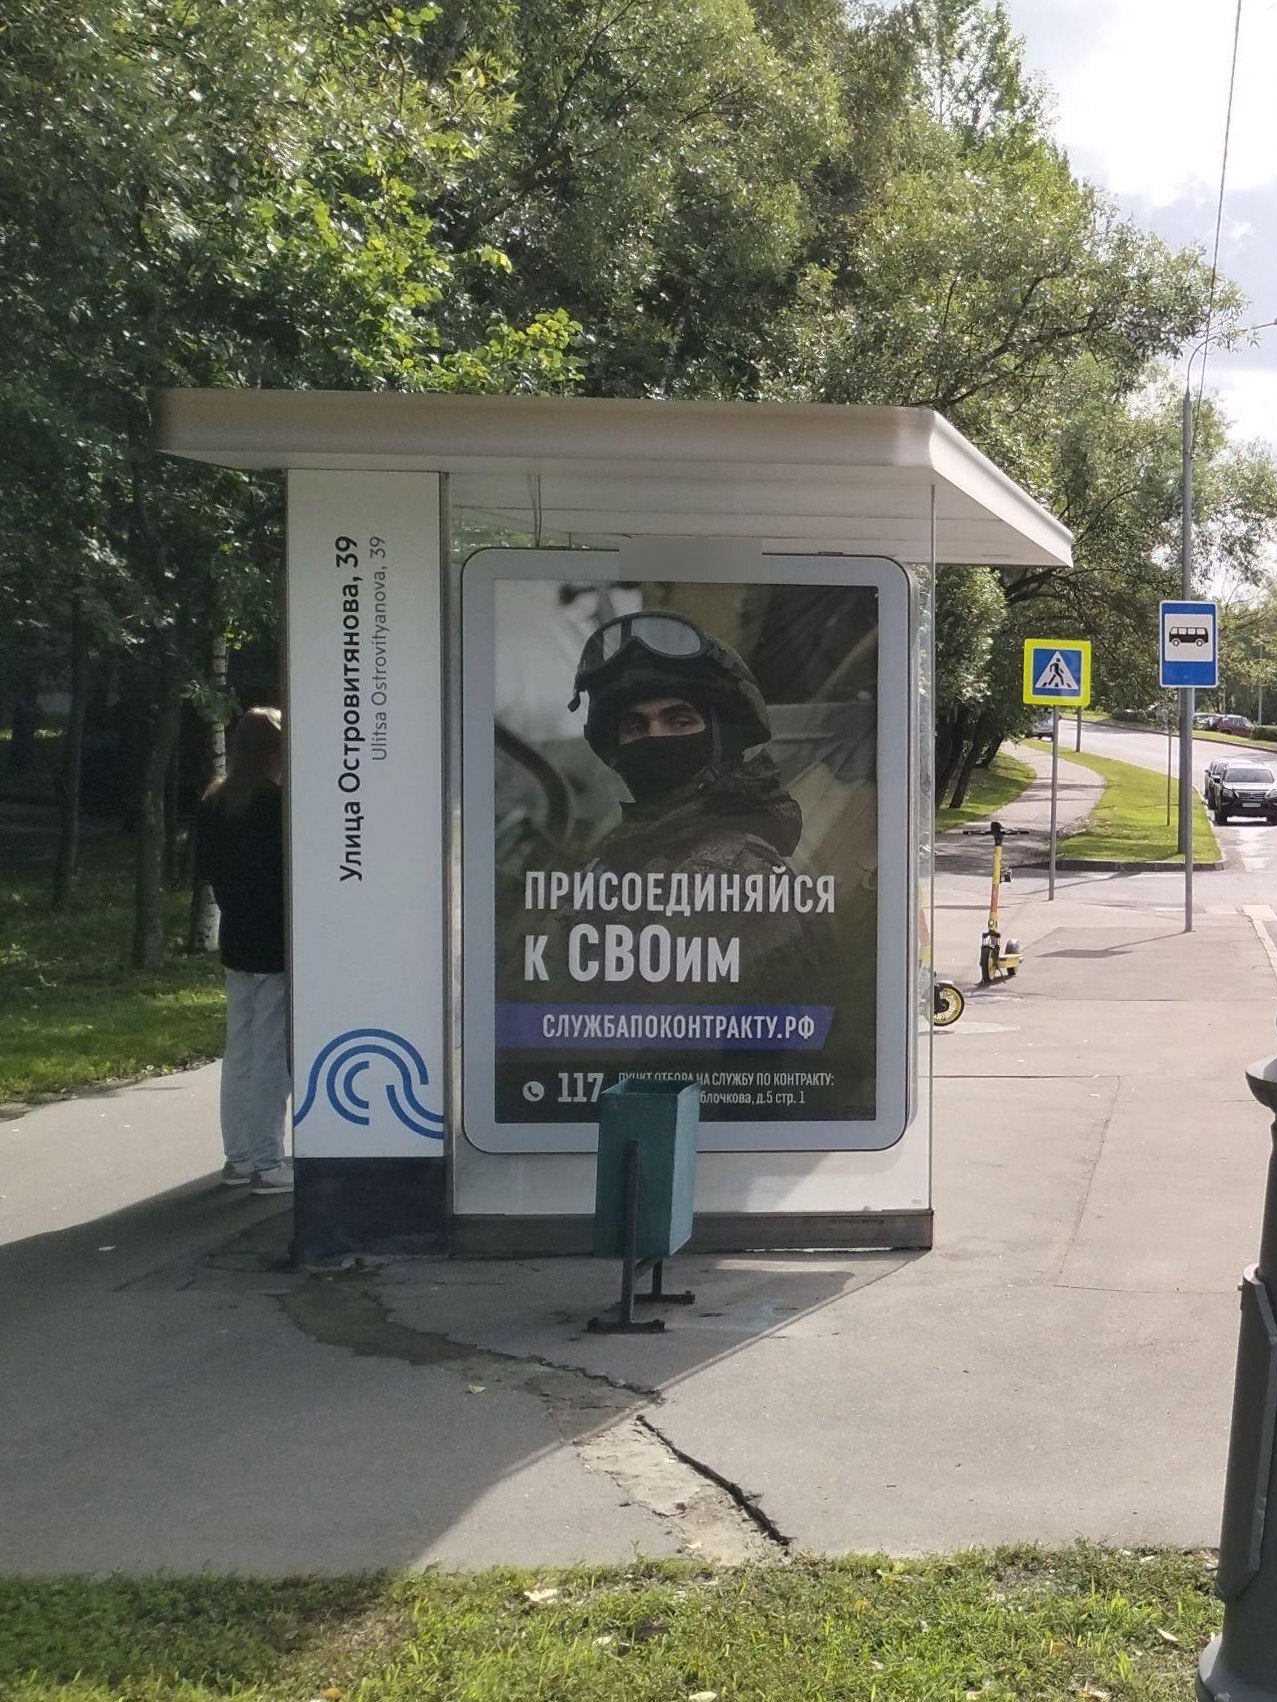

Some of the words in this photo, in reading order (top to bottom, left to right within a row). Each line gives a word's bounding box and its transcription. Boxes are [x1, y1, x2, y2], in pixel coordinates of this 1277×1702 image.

[335, 535, 359, 569] 39
[369, 535, 386, 559] 39
[370, 565, 391, 706] Ostrovityanova,
[337, 576, 365, 793] Островитянова,
[372, 711, 388, 761] Ulitsa
[338, 801, 363, 883] Улица
[524, 865, 836, 917] ПРИСОЕДИНЯЙСЯ
[542, 1013, 816, 1040] СЛУЖБАПОКОНТРАКТУ.РФ
[557, 1072, 605, 1103] 117
[711, 1072, 754, 1086] СЛУЖБУ
[756, 1072, 771, 1086] ПО
[773, 1072, 835, 1086] КОНТРАКТУ:
[700, 1090, 755, 1105] блочкова,
[775, 1092, 797, 1106] стр.
[799, 1090, 806, 1104] 1
